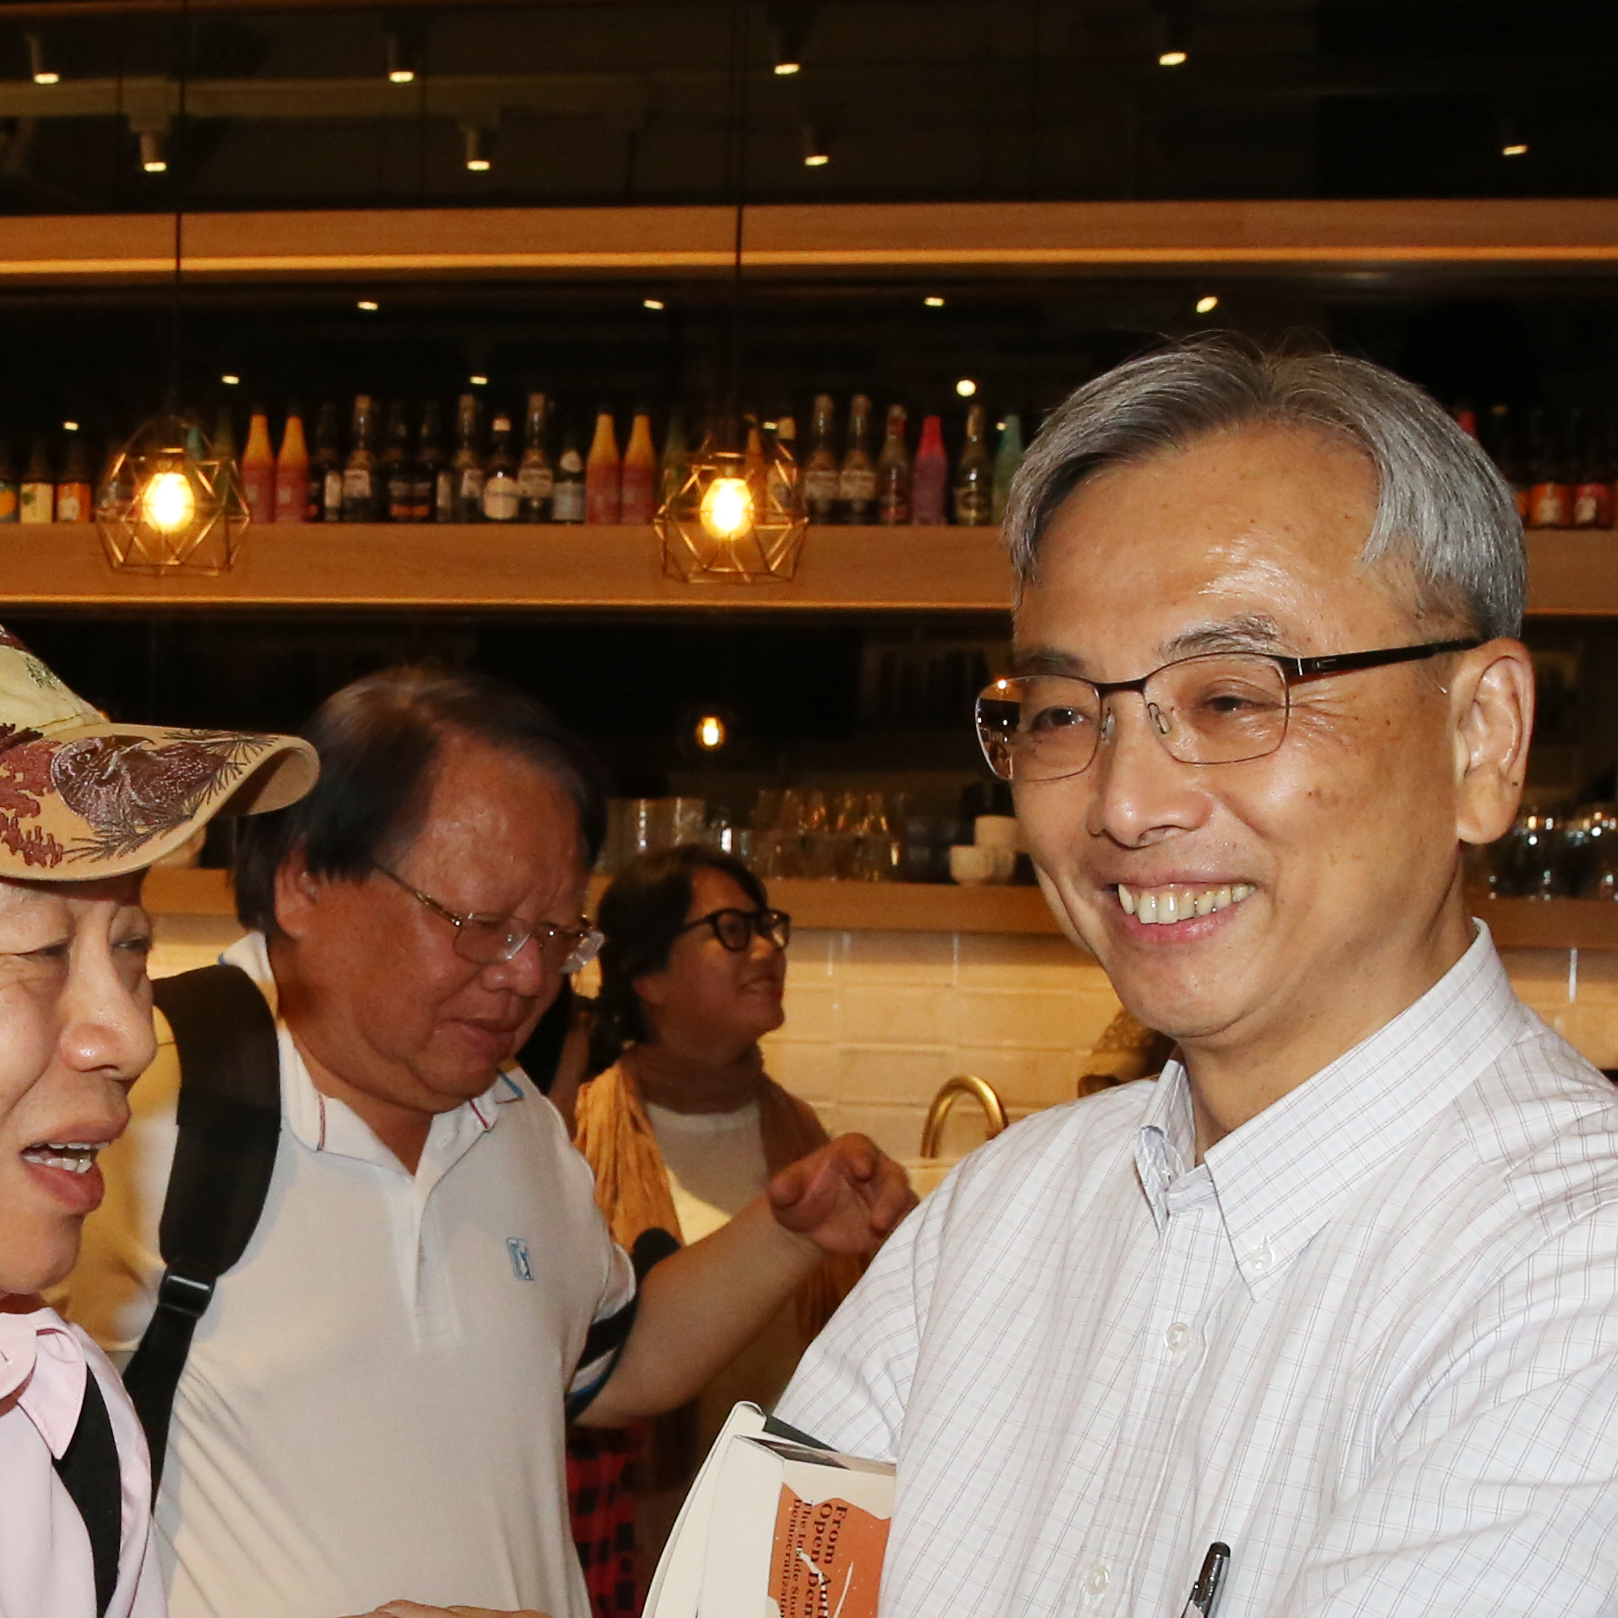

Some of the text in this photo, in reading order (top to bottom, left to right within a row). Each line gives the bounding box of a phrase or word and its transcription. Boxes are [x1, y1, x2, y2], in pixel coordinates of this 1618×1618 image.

[801, 1500, 813, 1529] The
[810, 1503, 833, 1562] Open
[824, 1506, 848, 1564] From
[793, 1534, 805, 1581] Inside
